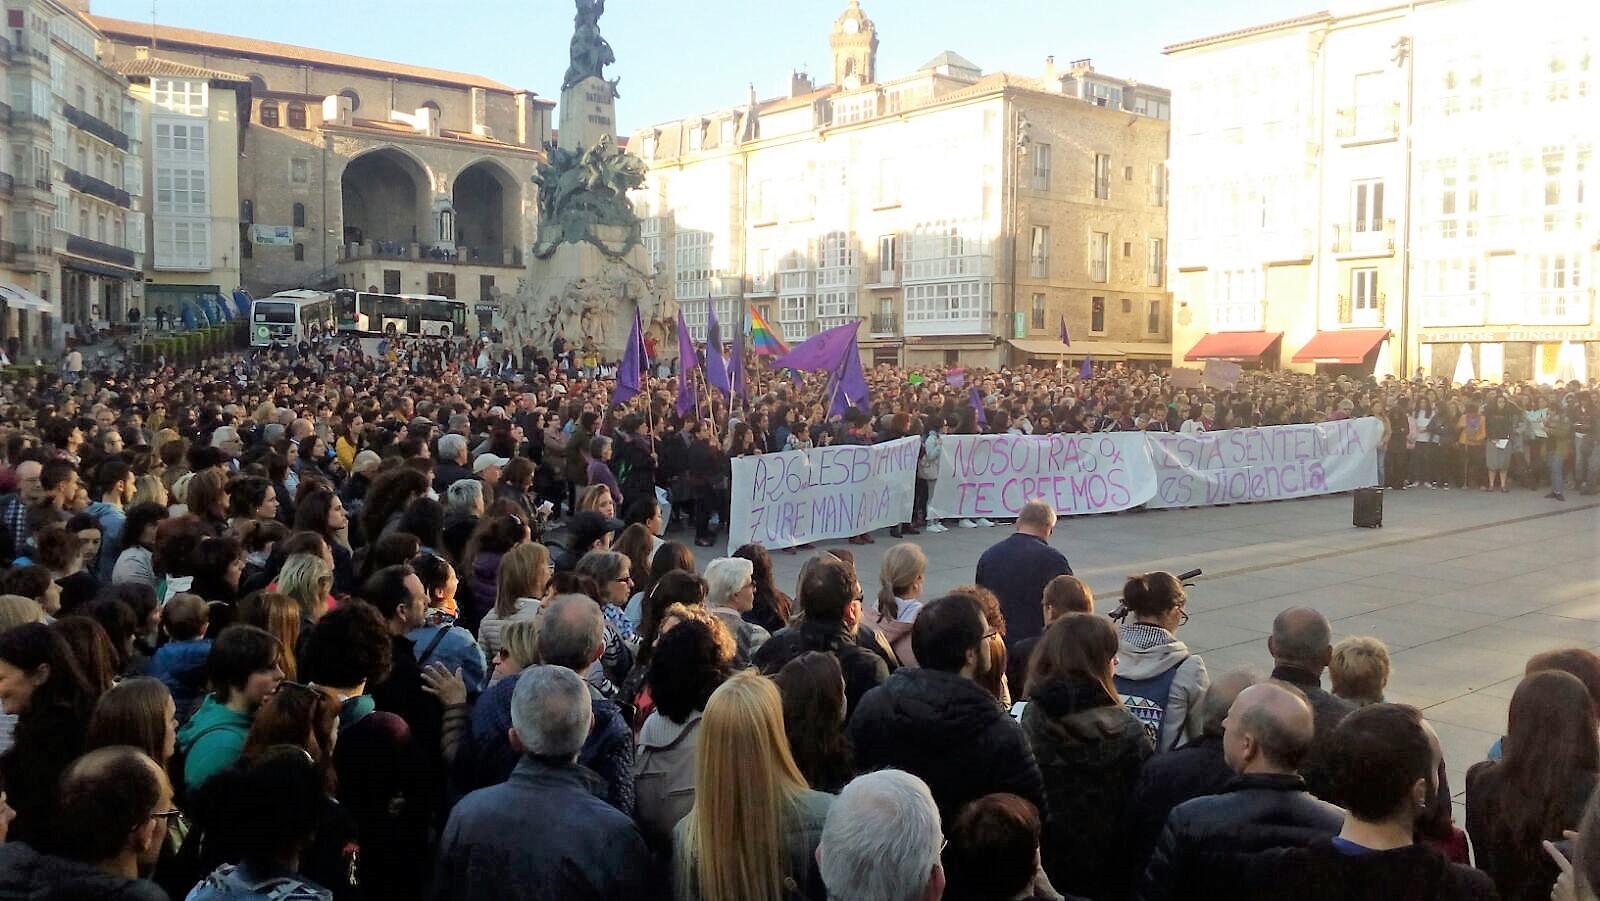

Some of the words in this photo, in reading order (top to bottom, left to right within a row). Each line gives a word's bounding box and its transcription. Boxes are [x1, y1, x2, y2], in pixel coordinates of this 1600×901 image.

[951, 434, 1098, 479] NOSOTRAS
[957, 483, 994, 514] TE
[1001, 469, 1131, 514] CREEMOS
